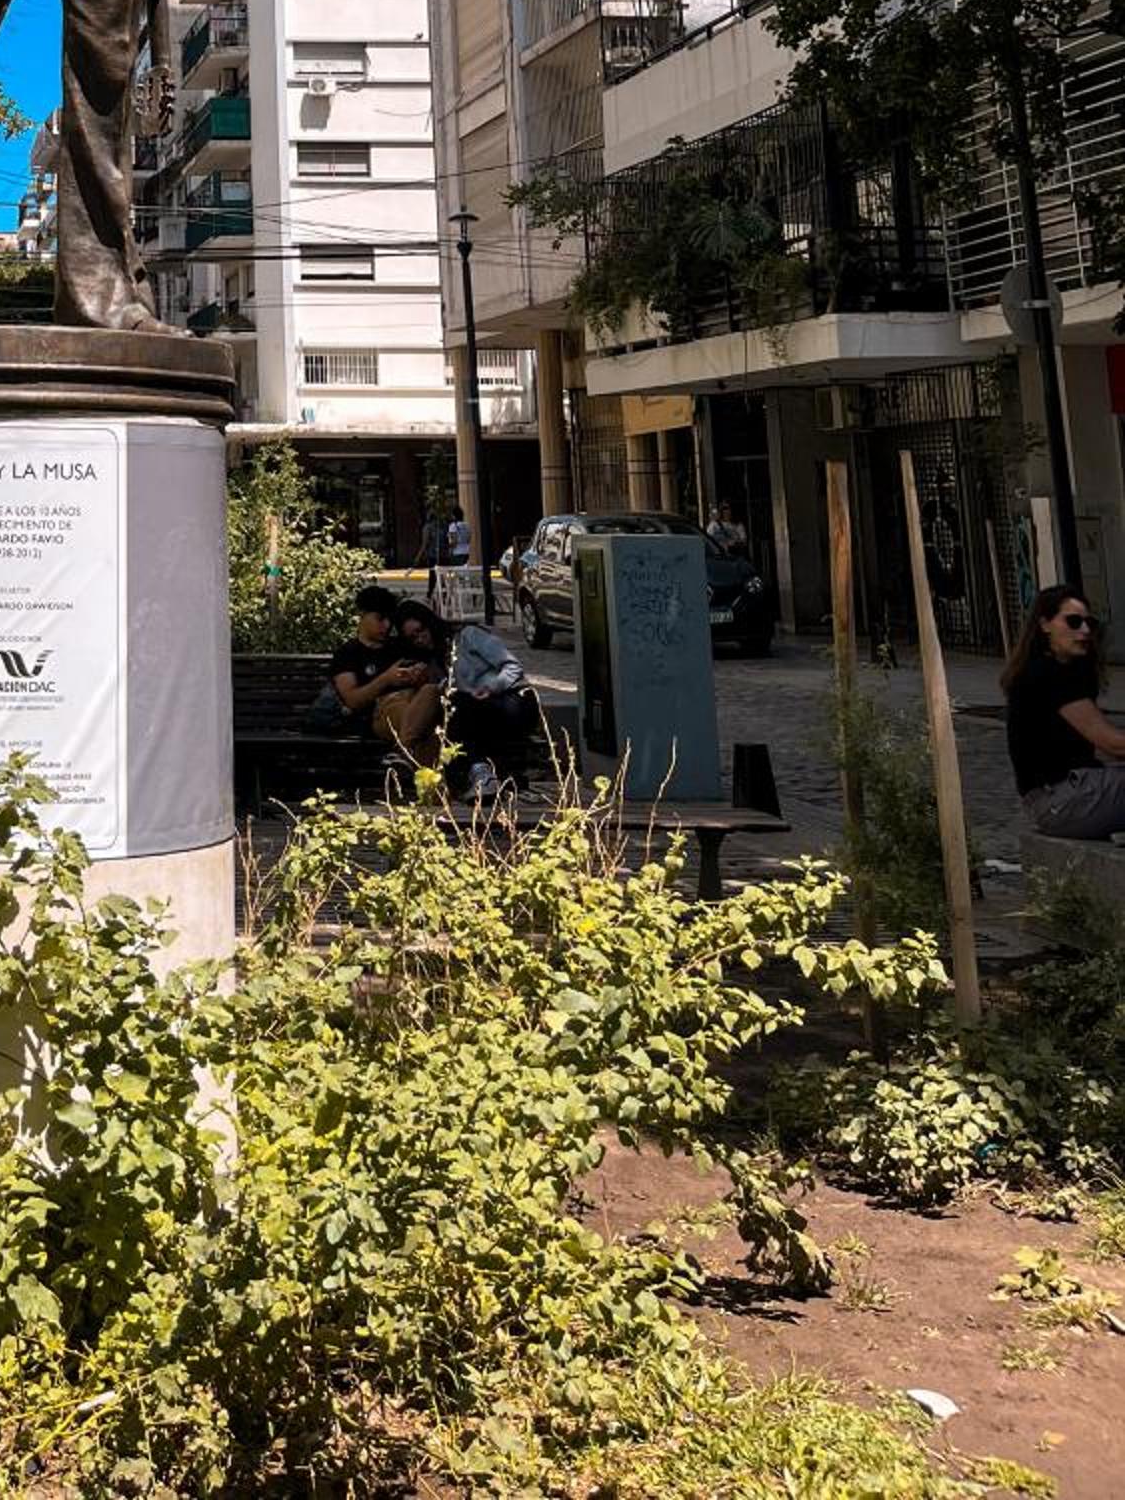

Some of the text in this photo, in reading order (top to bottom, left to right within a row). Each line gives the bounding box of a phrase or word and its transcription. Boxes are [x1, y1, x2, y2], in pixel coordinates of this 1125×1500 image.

[12, 463, 37, 480] LA
[44, 463, 98, 481] MUSA
[5, 506, 12, 516] A
[15, 505, 36, 517] LOS
[51, 504, 82, 517] AÑOS
[59, 520, 74, 531] DE
[31, 534, 64, 544] FAVIO
